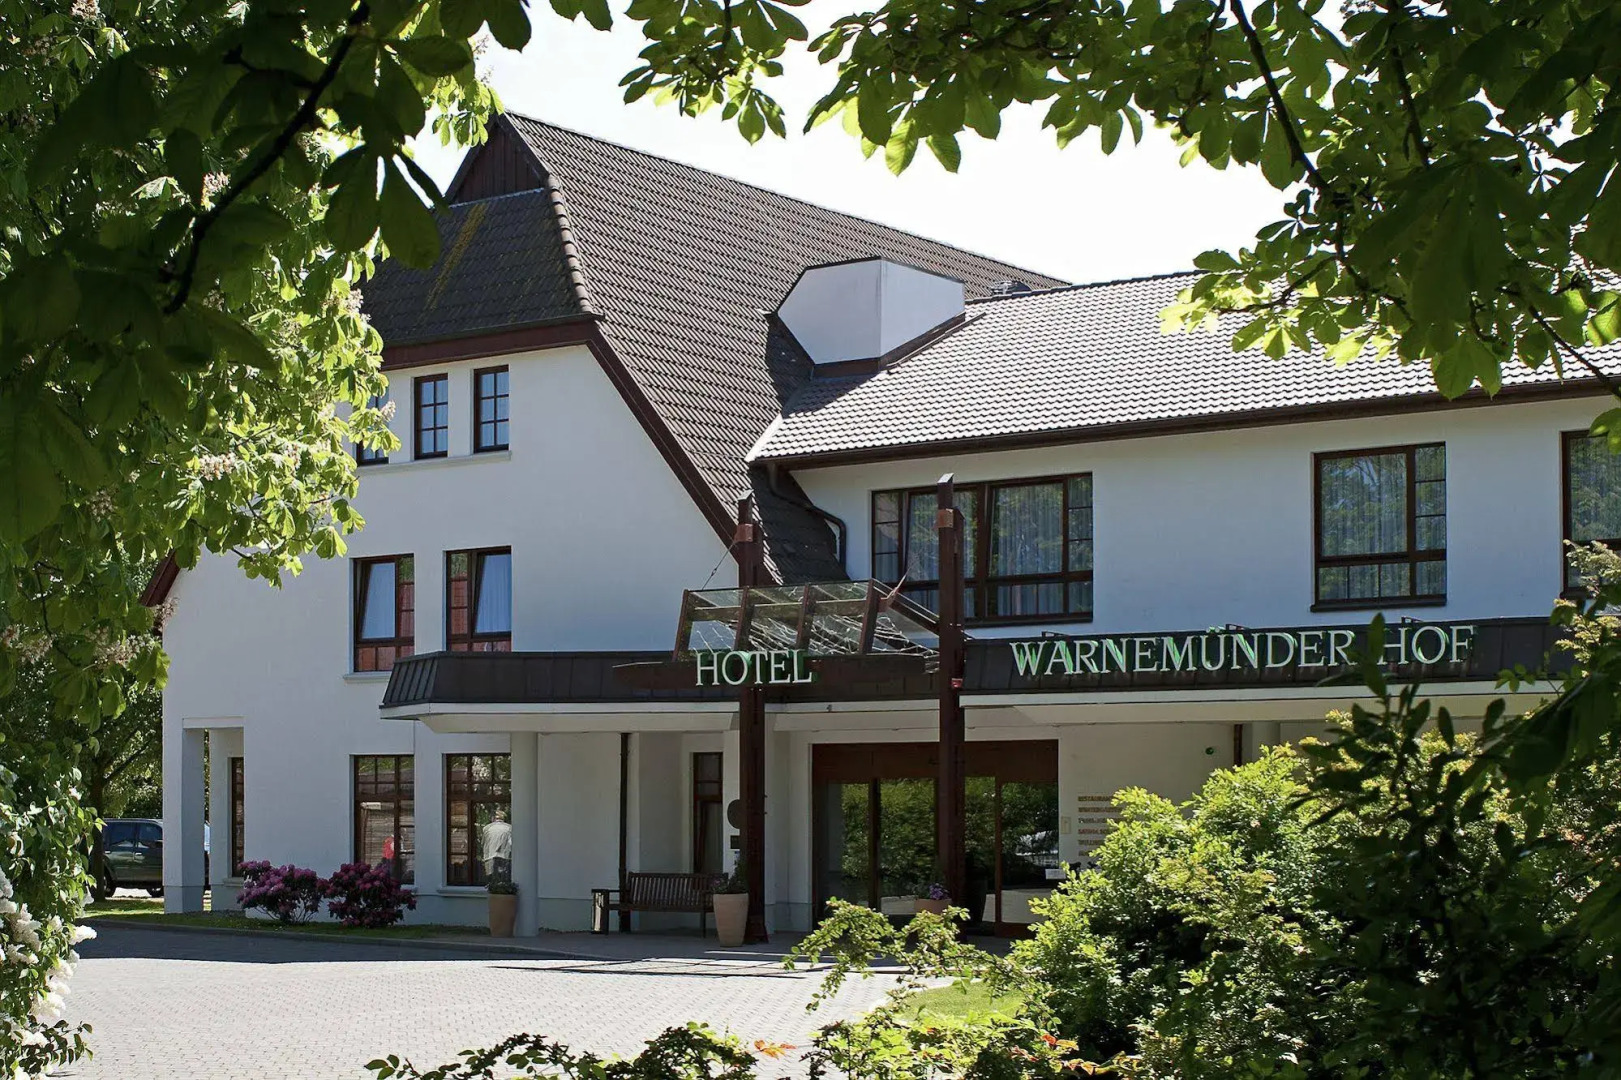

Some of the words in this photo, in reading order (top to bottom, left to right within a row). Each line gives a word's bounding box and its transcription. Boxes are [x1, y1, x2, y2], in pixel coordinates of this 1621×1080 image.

[695, 649, 812, 686] HOTEL
[1009, 626, 1358, 676] WARNEMÜNDER
[1376, 625, 1474, 665] HOF
